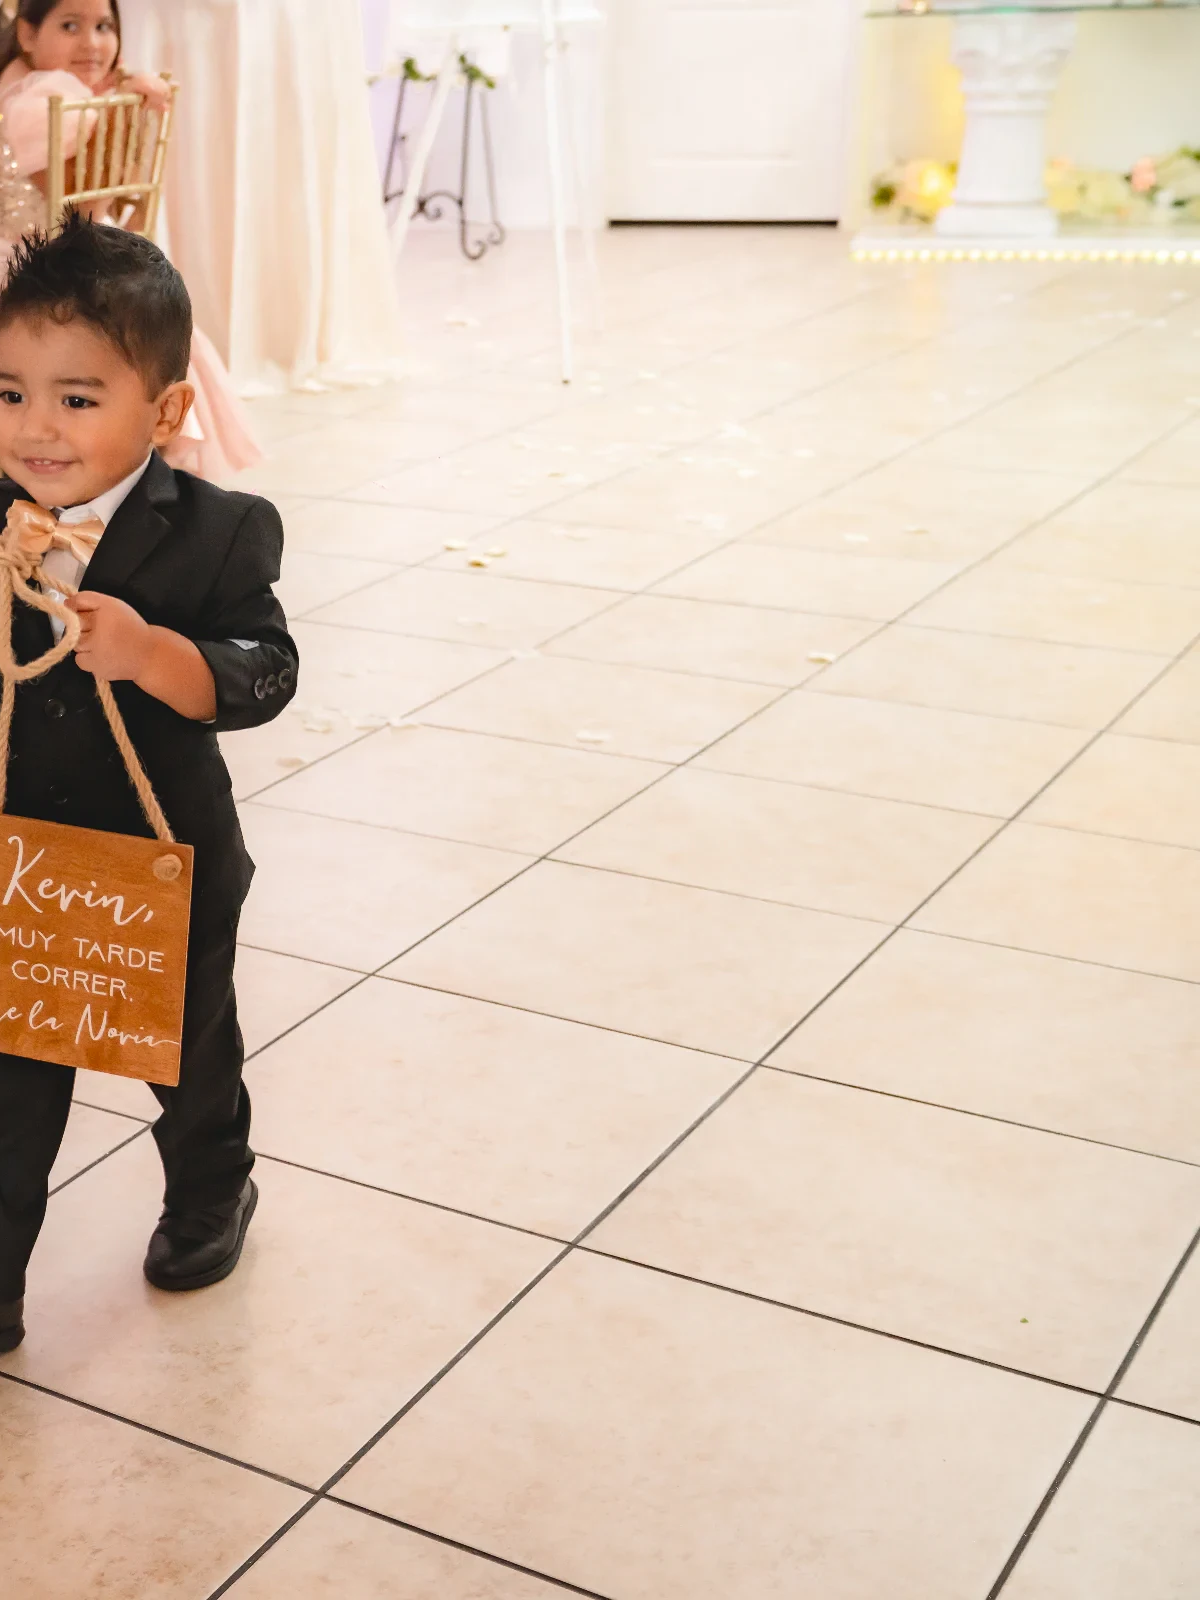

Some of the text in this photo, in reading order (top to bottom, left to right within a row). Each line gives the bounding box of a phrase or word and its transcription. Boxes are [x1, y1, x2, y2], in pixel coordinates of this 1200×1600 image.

[2, 835, 154, 926] Kevin,
[73, 937, 165, 973] TARDE
[11, 960, 134, 1002] CORRER.
[27, 1000, 64, 1031] la
[75, 1003, 180, 1048] Novia
